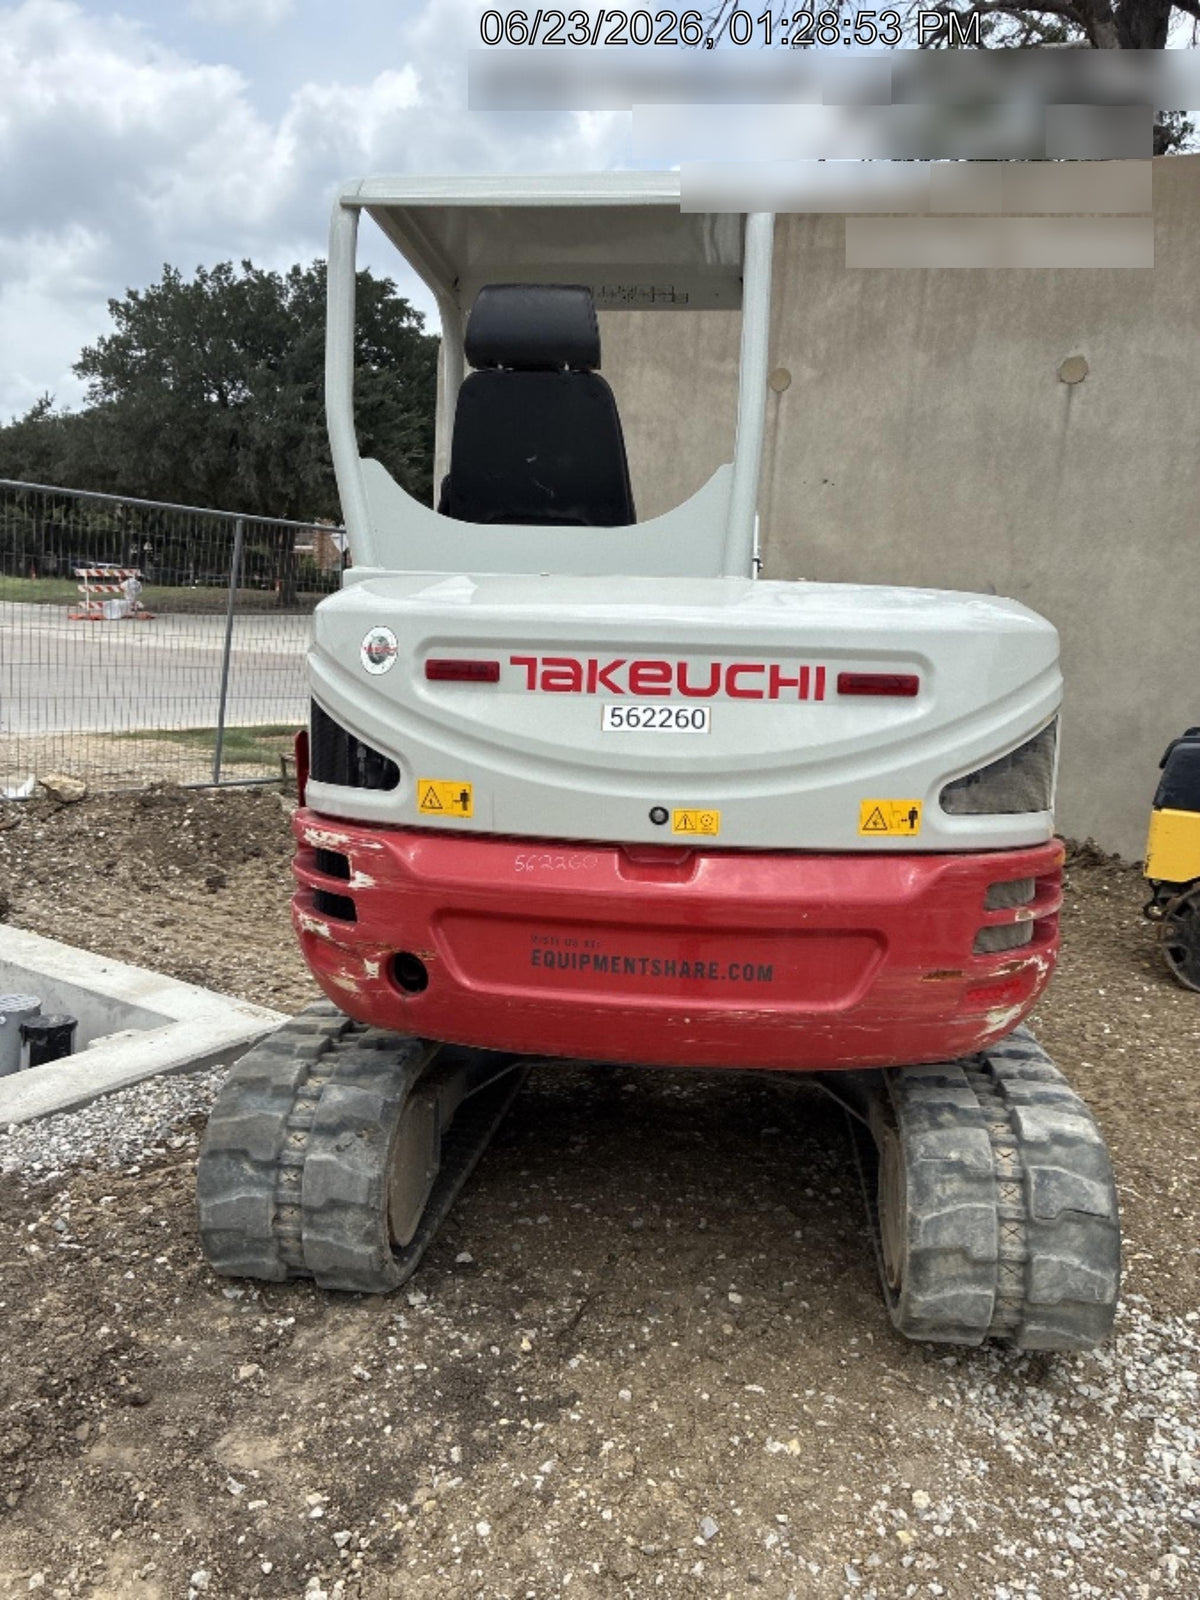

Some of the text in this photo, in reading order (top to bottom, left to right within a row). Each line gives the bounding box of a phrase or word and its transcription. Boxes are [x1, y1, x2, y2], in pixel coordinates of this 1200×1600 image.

[610, 706, 706, 730] 562260
[514, 854, 598, 872] 562260
[530, 949, 773, 982] EQUIPMENTSHARE.COM
